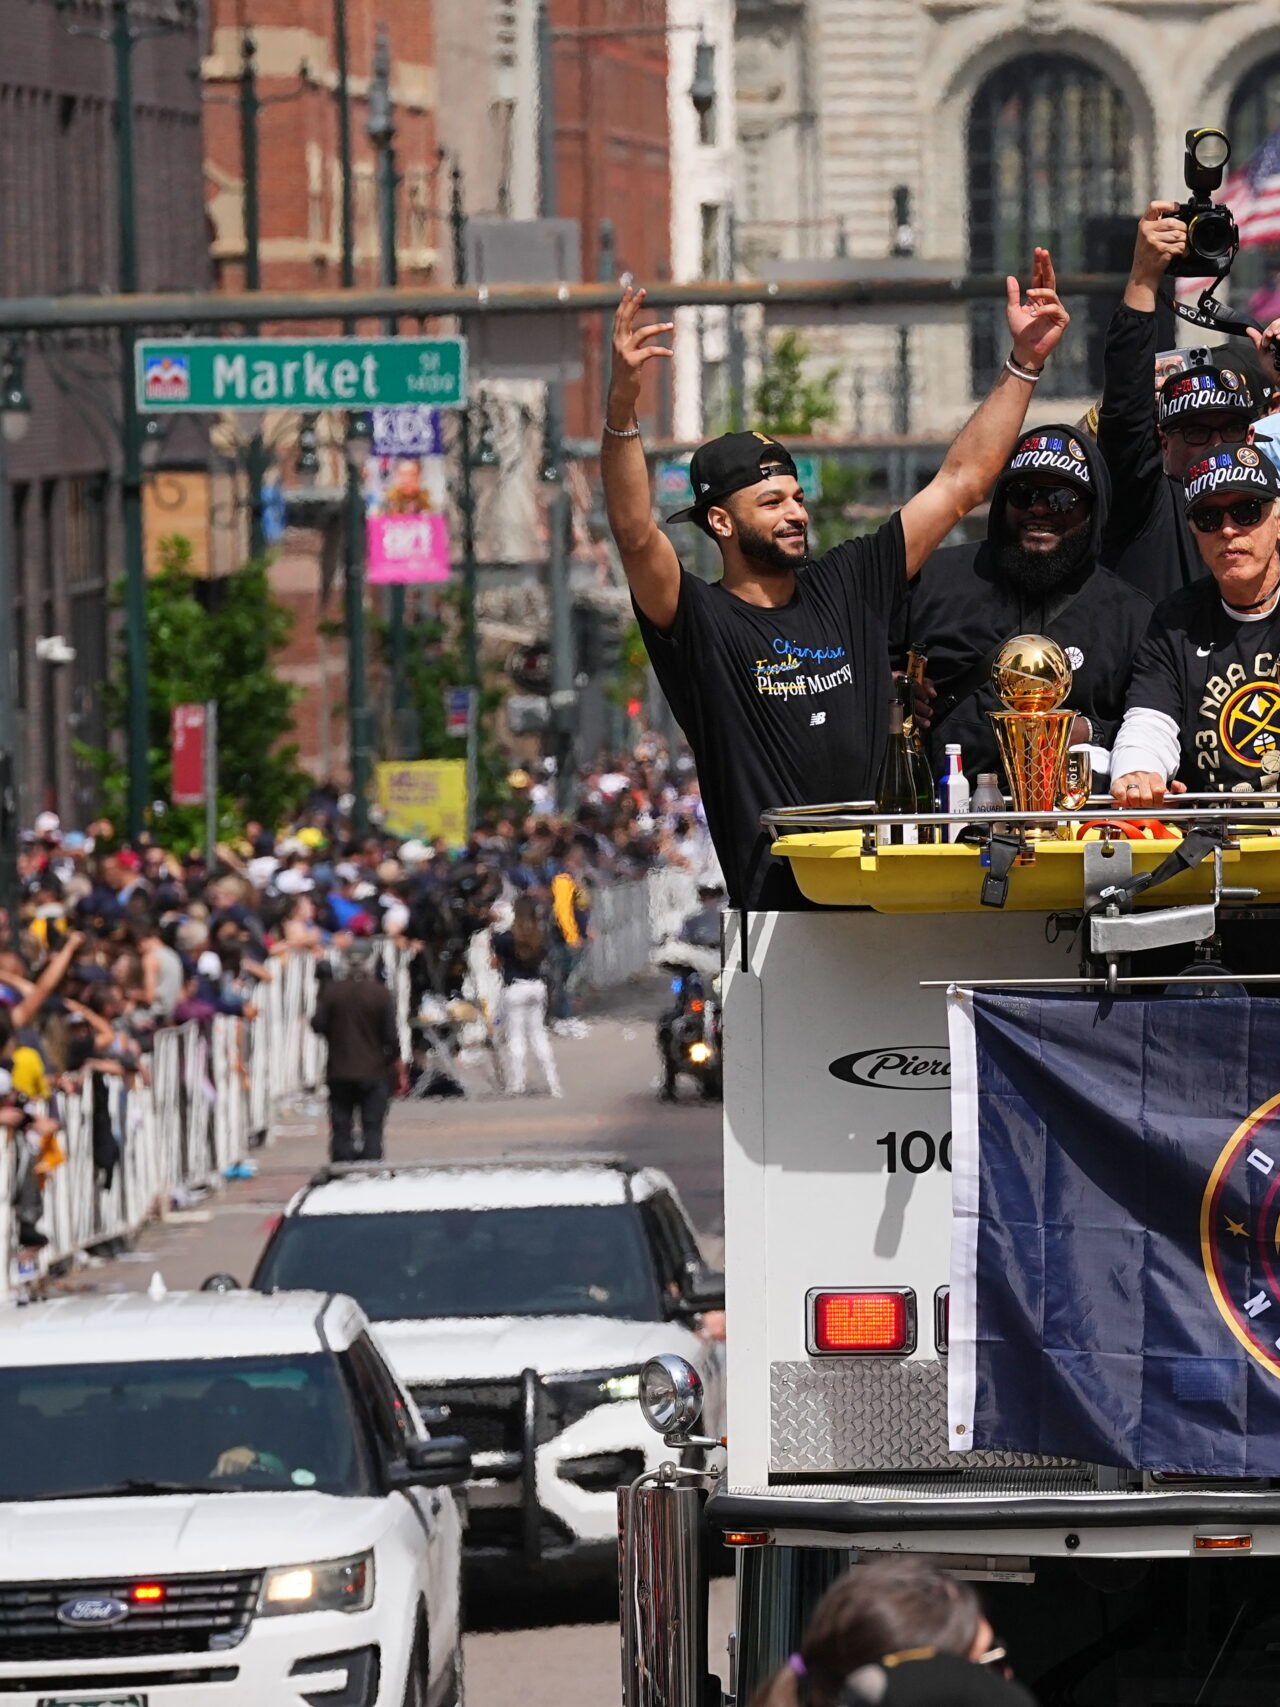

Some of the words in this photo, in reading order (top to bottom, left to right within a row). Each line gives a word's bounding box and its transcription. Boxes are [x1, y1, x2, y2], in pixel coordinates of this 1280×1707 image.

[212, 351, 379, 398] Market
[757, 675, 807, 702] Playoff
[807, 664, 853, 695] Murray
[71, 1600, 112, 1619] Ford
